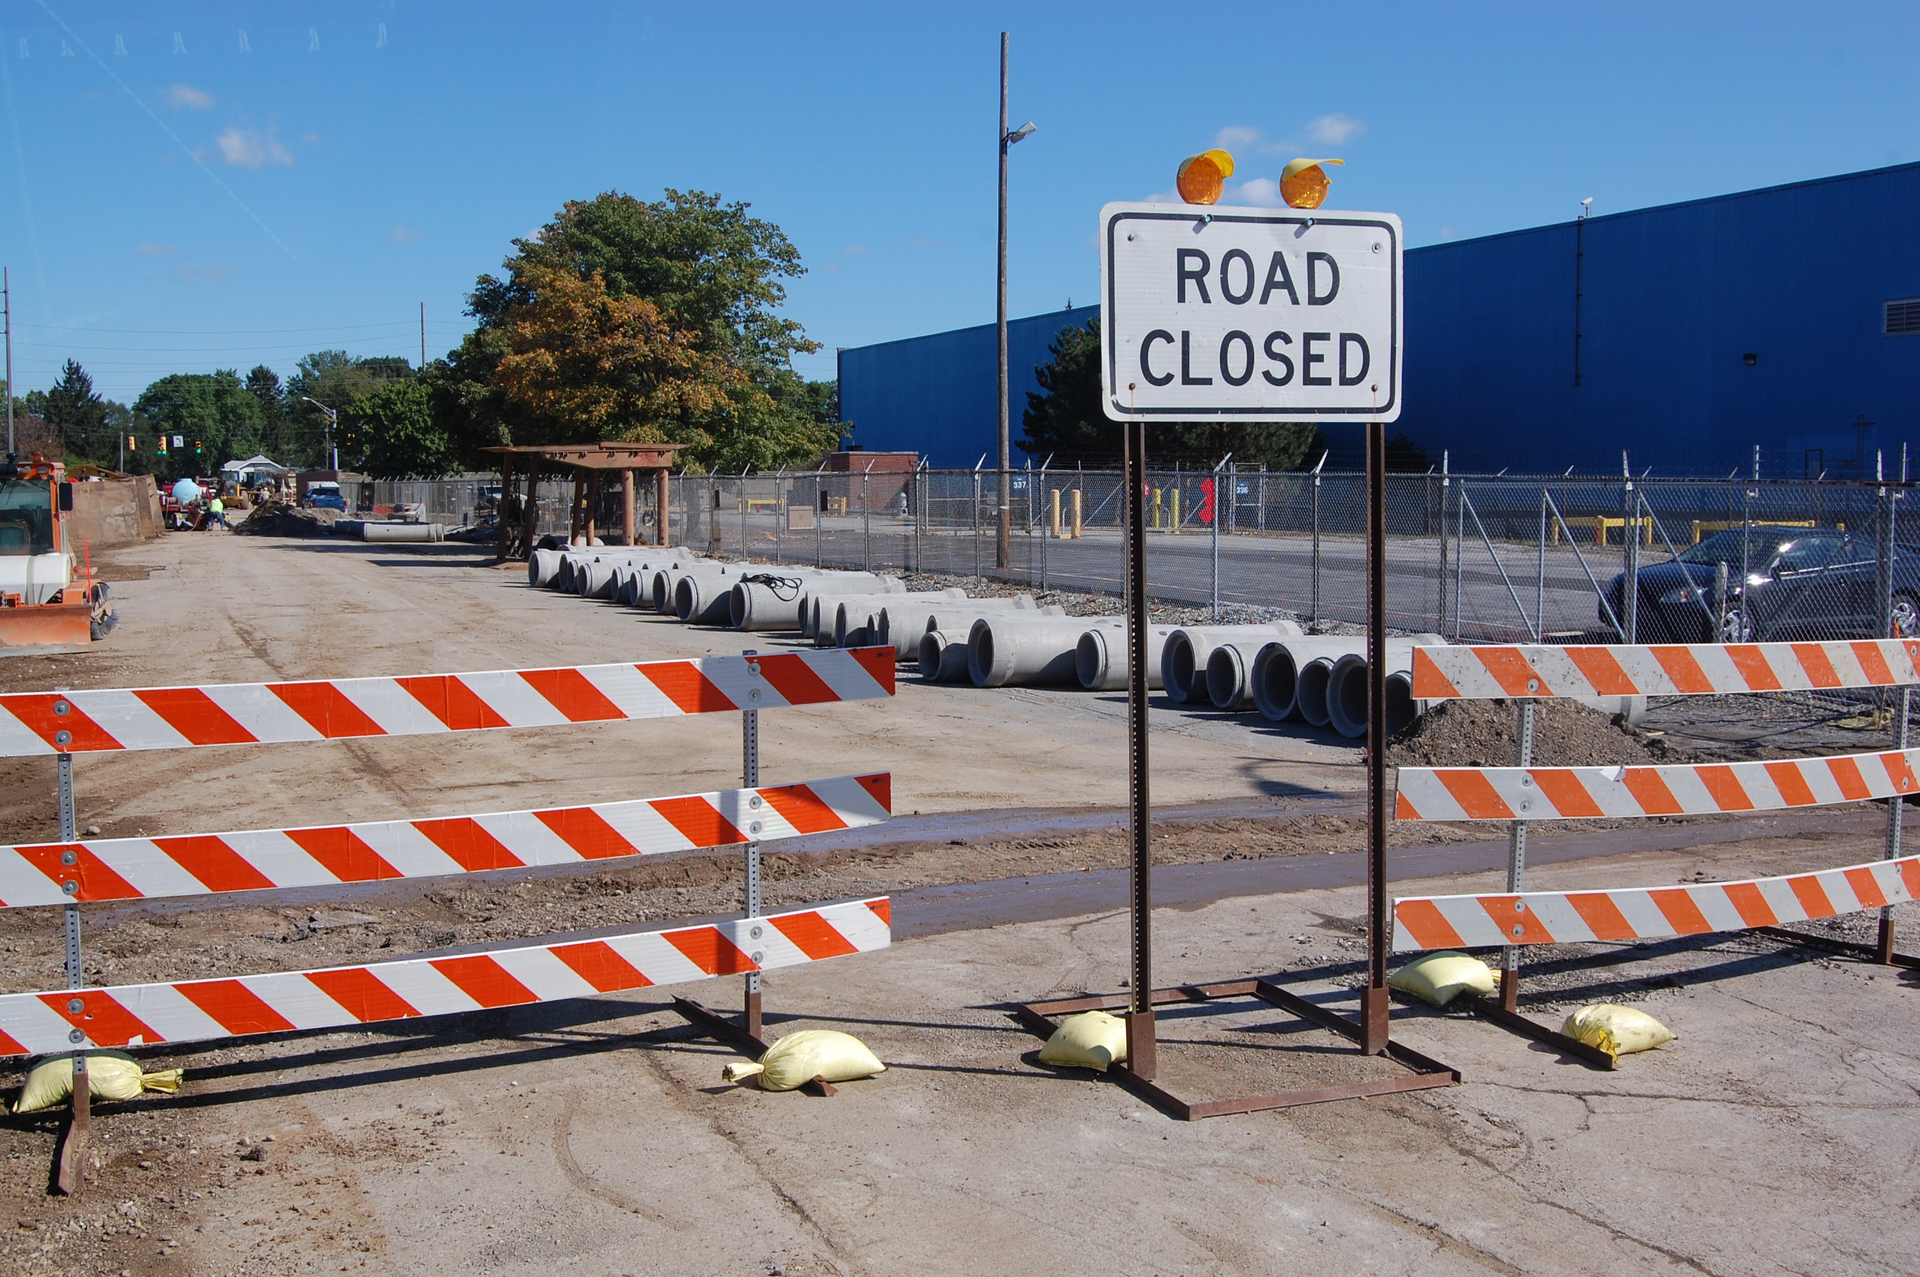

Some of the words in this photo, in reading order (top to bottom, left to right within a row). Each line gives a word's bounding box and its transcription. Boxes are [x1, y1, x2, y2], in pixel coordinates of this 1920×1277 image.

[1176, 248, 1341, 306] ROAD
[1139, 329, 1371, 387] CLOSED
[1013, 481, 1027, 489] 337
